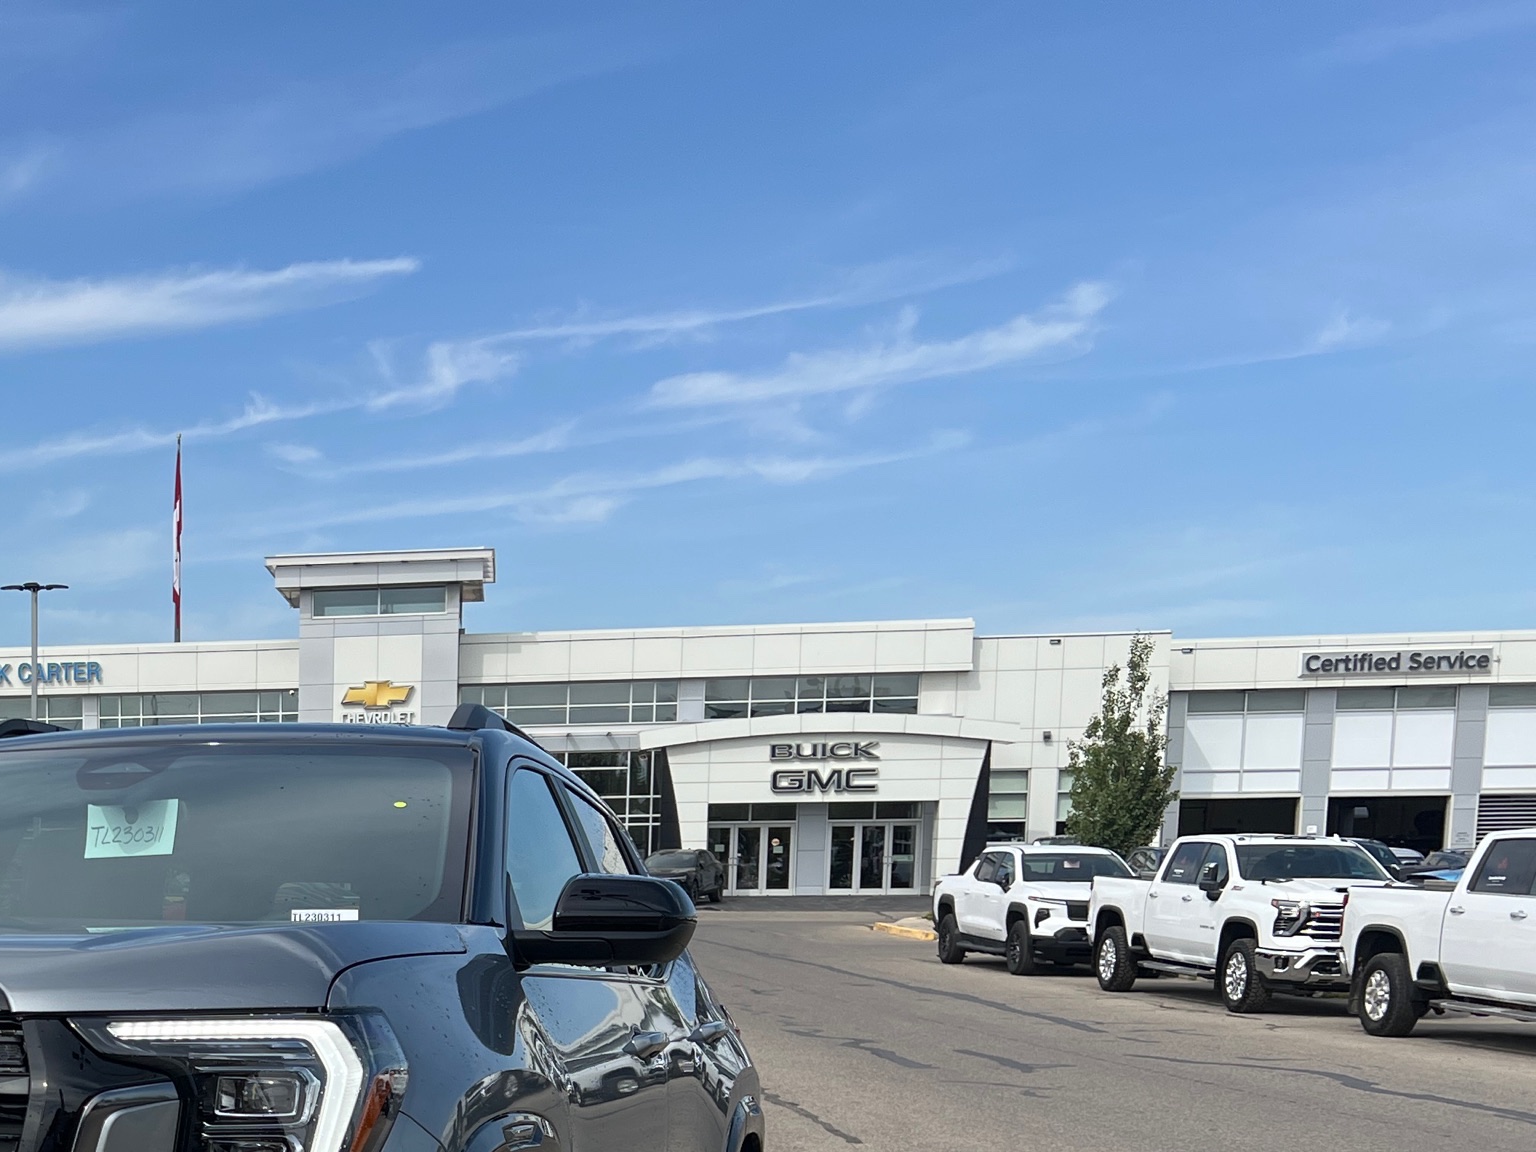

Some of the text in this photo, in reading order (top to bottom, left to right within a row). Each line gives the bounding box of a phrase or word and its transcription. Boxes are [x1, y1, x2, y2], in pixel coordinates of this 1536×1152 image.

[17, 661, 102, 684] CARTER
[1305, 651, 1490, 673] Certified Service
[770, 741, 881, 760] BUICK
[770, 767, 879, 793] GMC
[91, 826, 164, 847] TL230311
